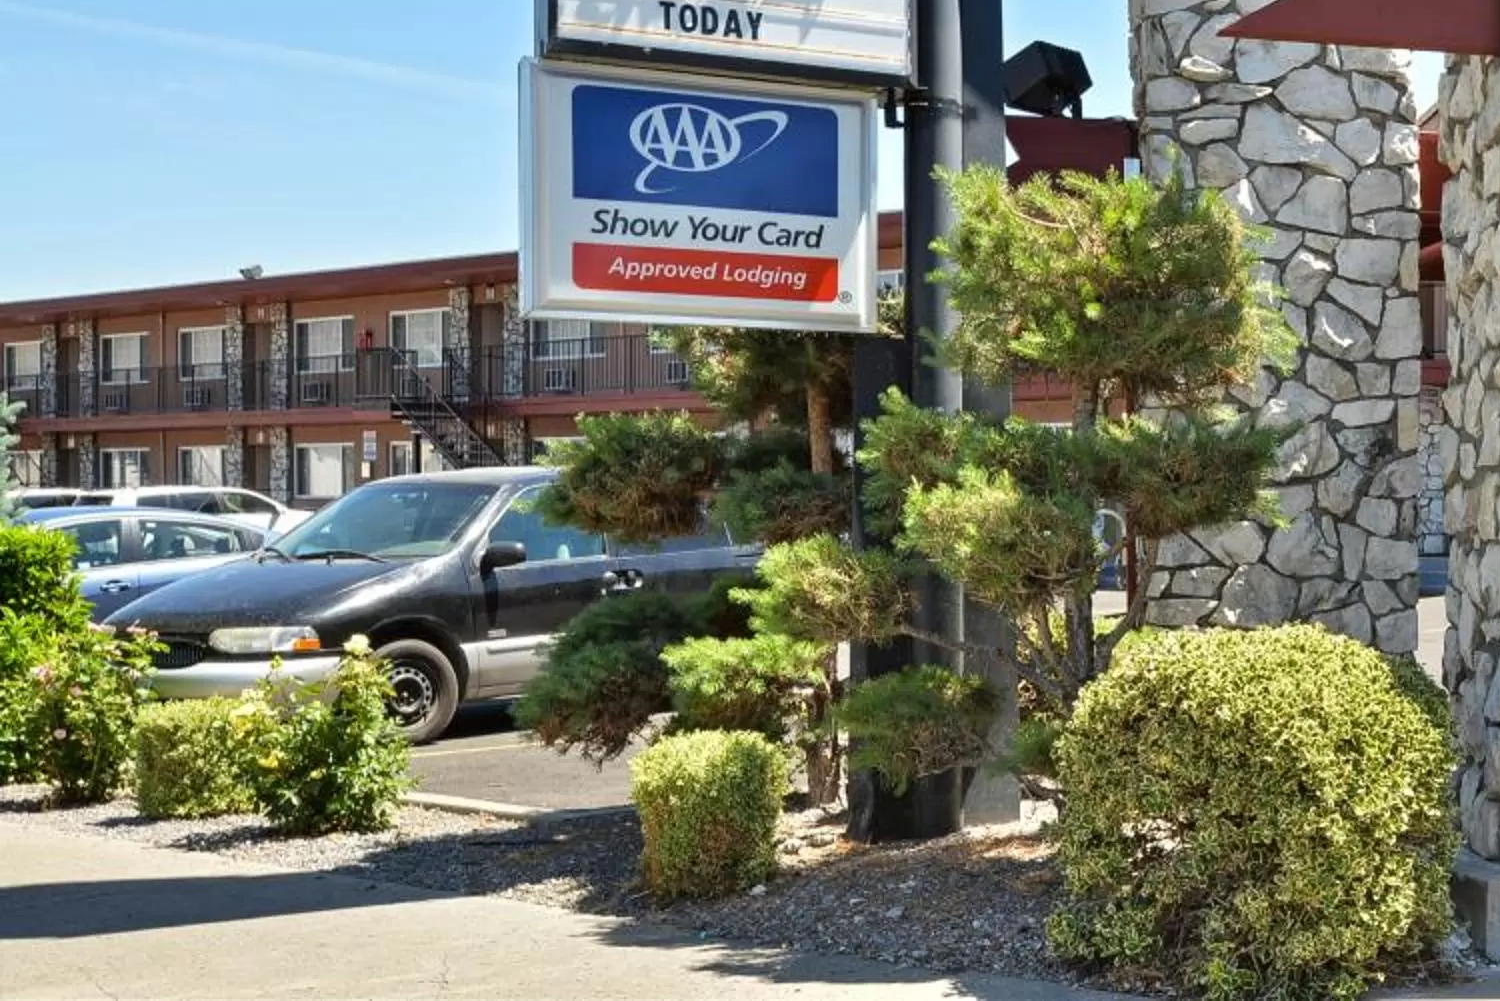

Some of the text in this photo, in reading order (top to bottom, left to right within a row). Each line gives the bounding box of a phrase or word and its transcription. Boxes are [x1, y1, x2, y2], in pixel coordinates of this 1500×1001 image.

[658, 1, 763, 40] TODAY
[591, 209, 825, 248] Show Your Card
[608, 257, 807, 289] Approved Lodging
